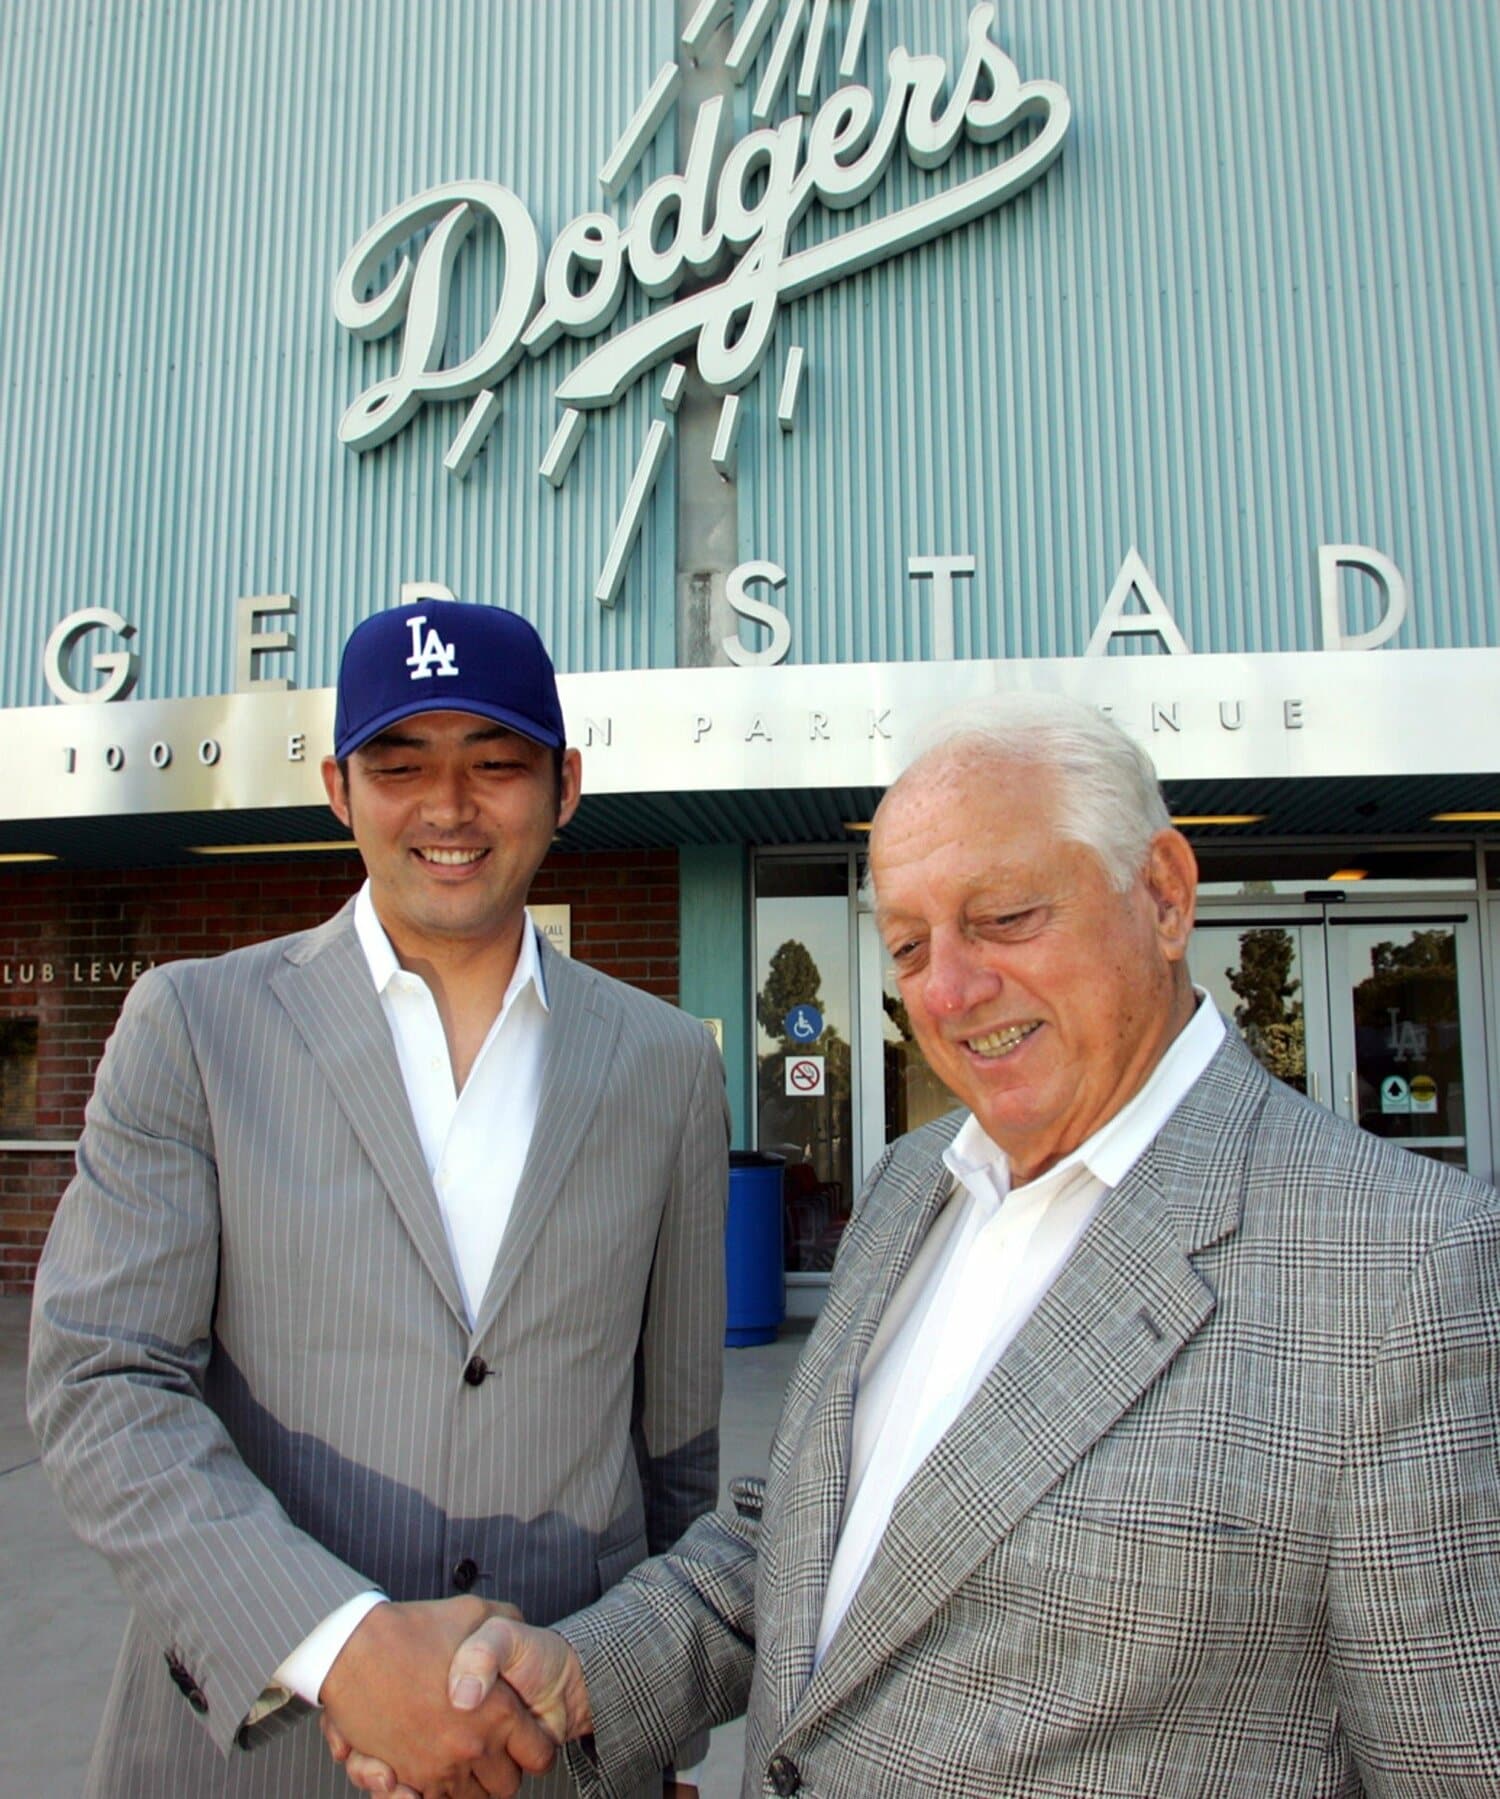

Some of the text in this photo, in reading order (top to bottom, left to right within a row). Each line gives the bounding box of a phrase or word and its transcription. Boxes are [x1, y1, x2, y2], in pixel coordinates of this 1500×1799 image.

[333, 2, 1070, 452] Dodgers
[721, 544, 1407, 667] STAD
[406, 615, 459, 680] LA
[64, 738, 221, 775] 1000
[693, 707, 894, 744] PARK
[1386, 1007, 1428, 1062] LA
